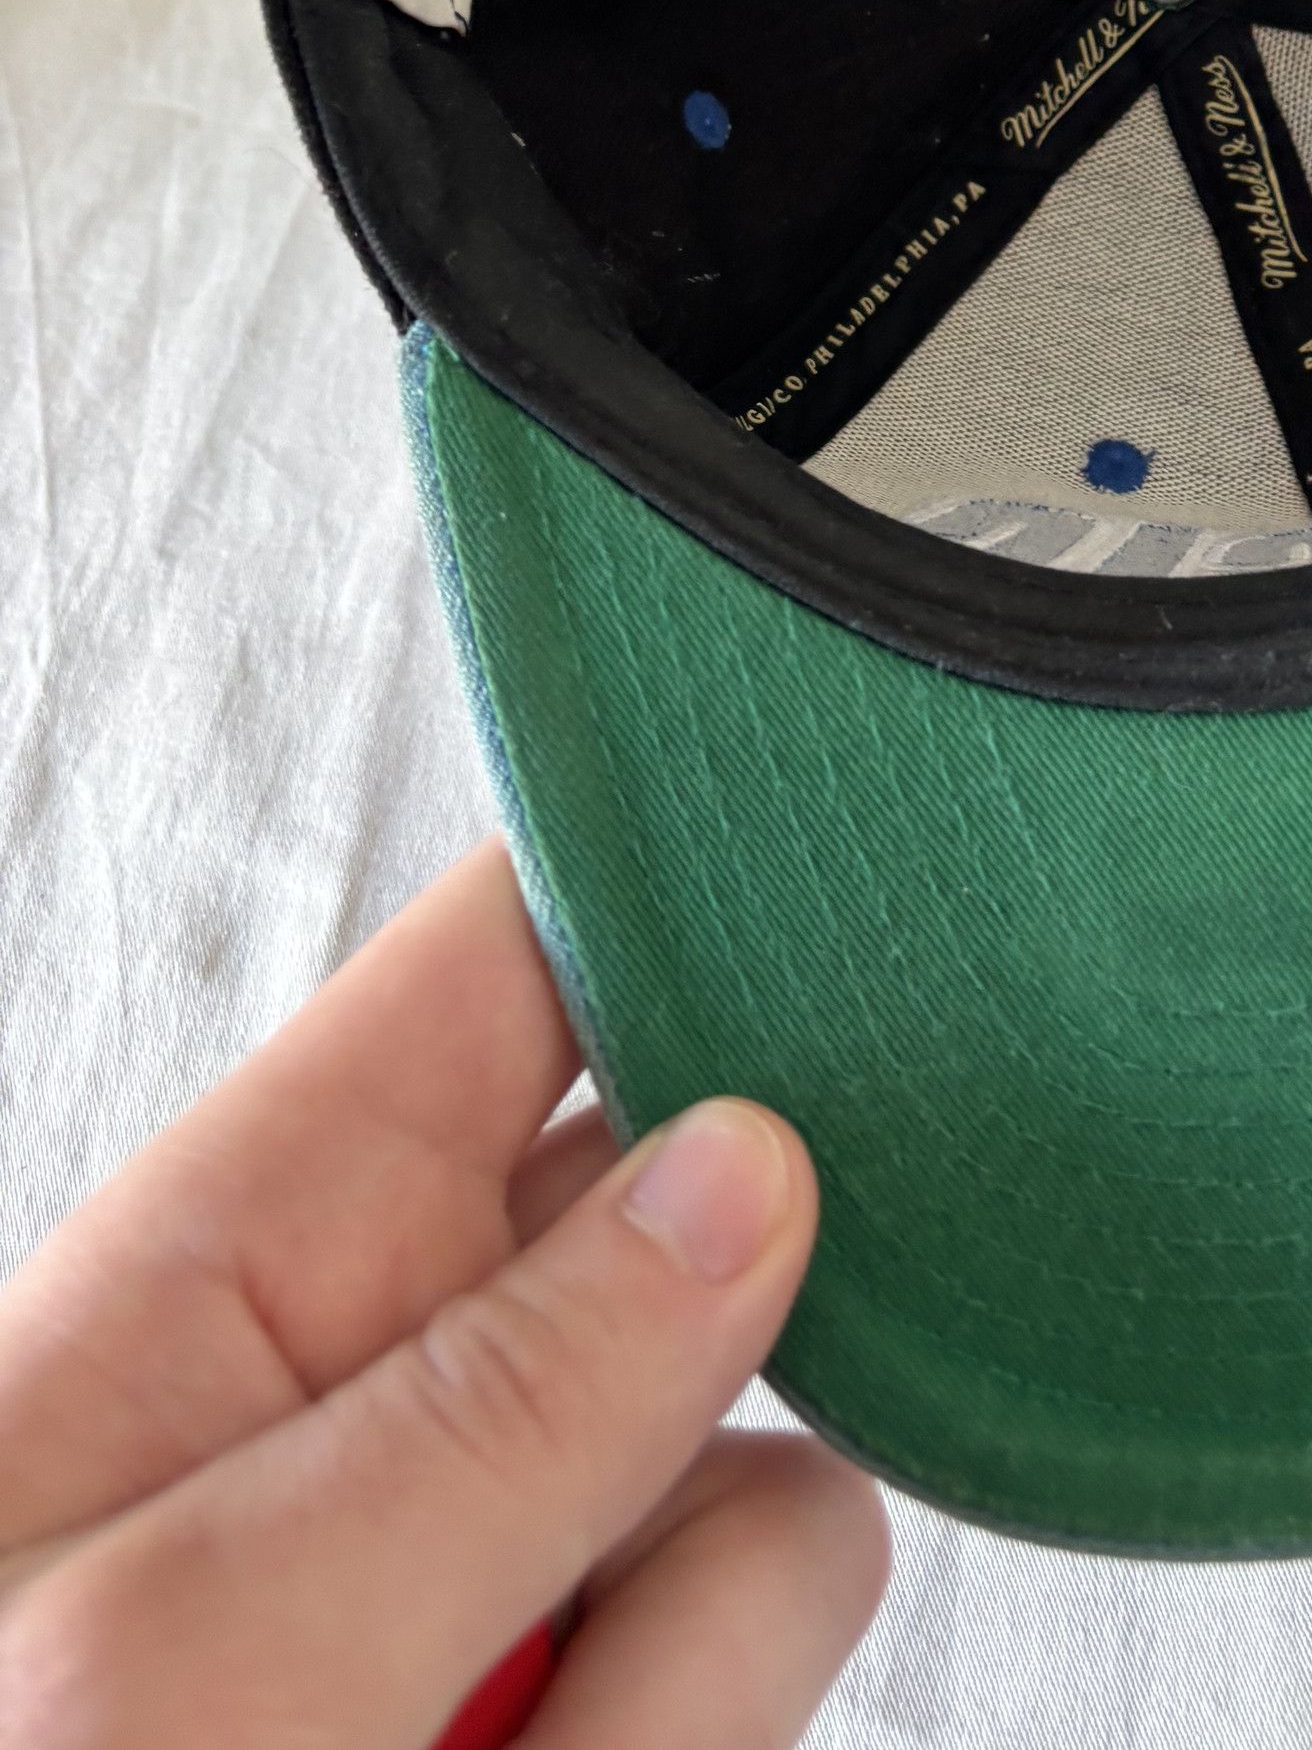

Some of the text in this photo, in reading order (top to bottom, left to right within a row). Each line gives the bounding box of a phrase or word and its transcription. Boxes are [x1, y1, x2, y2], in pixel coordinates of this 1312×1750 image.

[1000, 17, 1125, 148] Mitchell &
[1202, 54, 1246, 137] Ness
[1219, 134, 1256, 157] &
